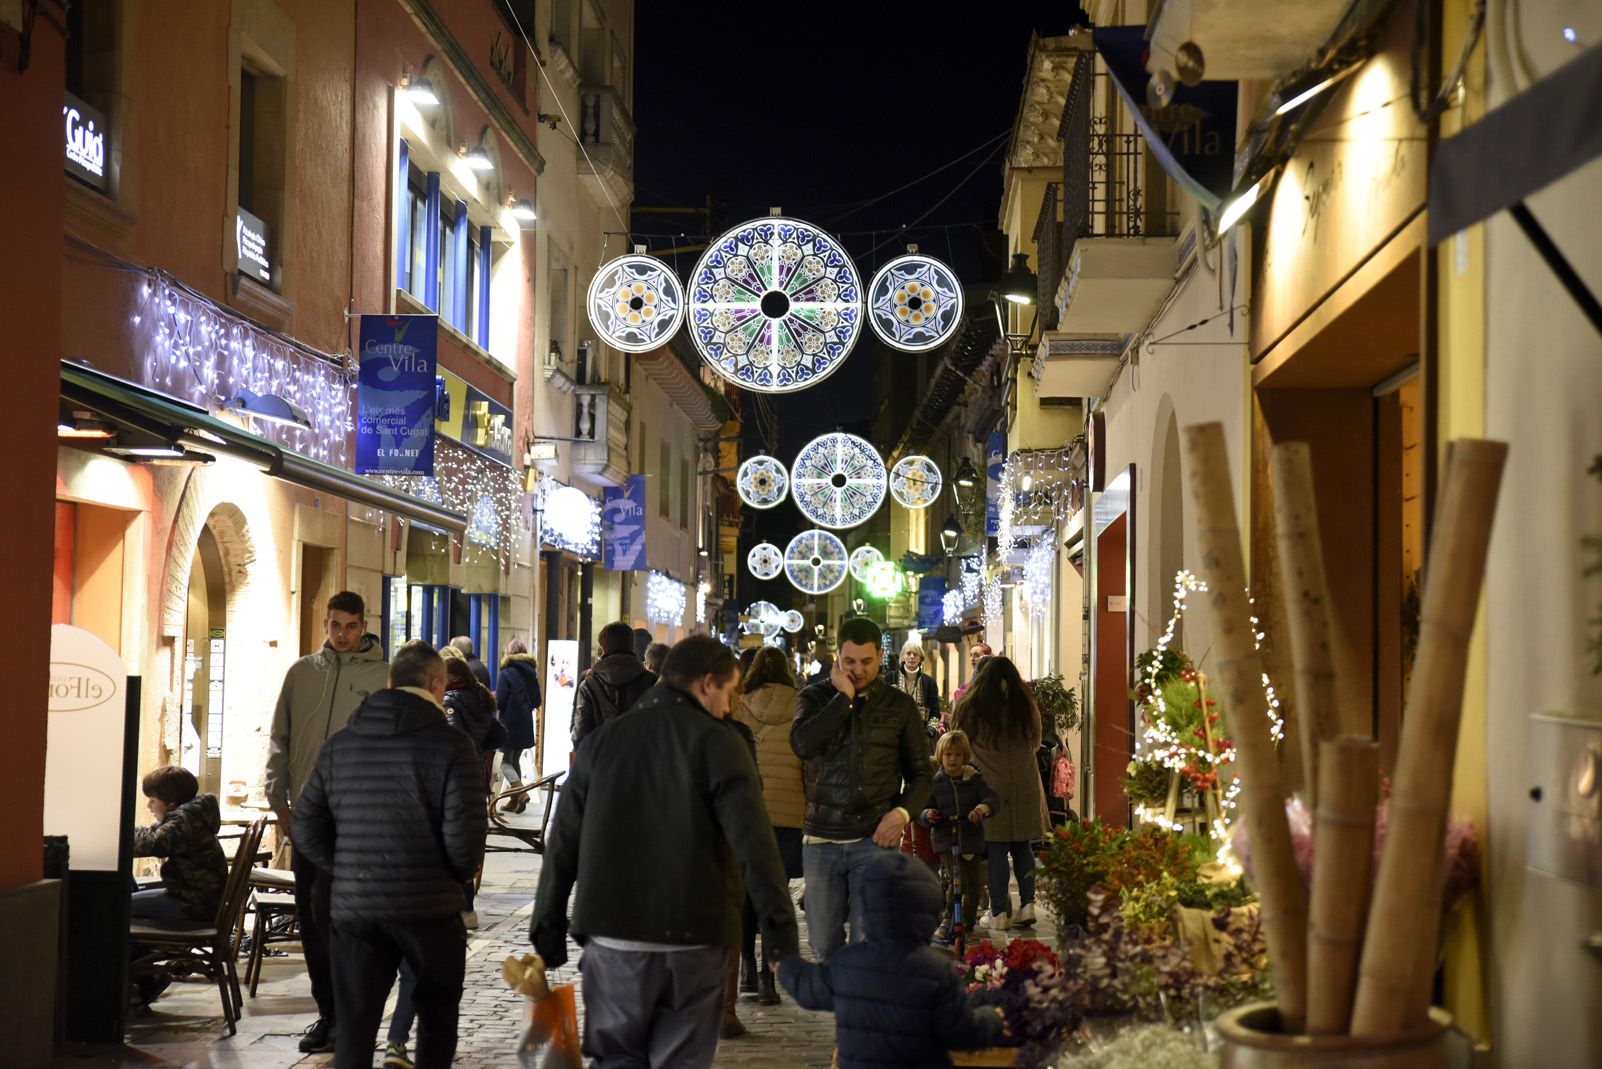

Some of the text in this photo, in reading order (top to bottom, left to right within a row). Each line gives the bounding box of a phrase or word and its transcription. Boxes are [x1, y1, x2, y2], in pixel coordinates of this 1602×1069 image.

[365, 339, 412, 354] Centre
[389, 352, 427, 373] Vila
[361, 416, 407, 425] comercial
[361, 425, 429, 437] de Sant Cugat
[377, 448, 385, 457] EL
